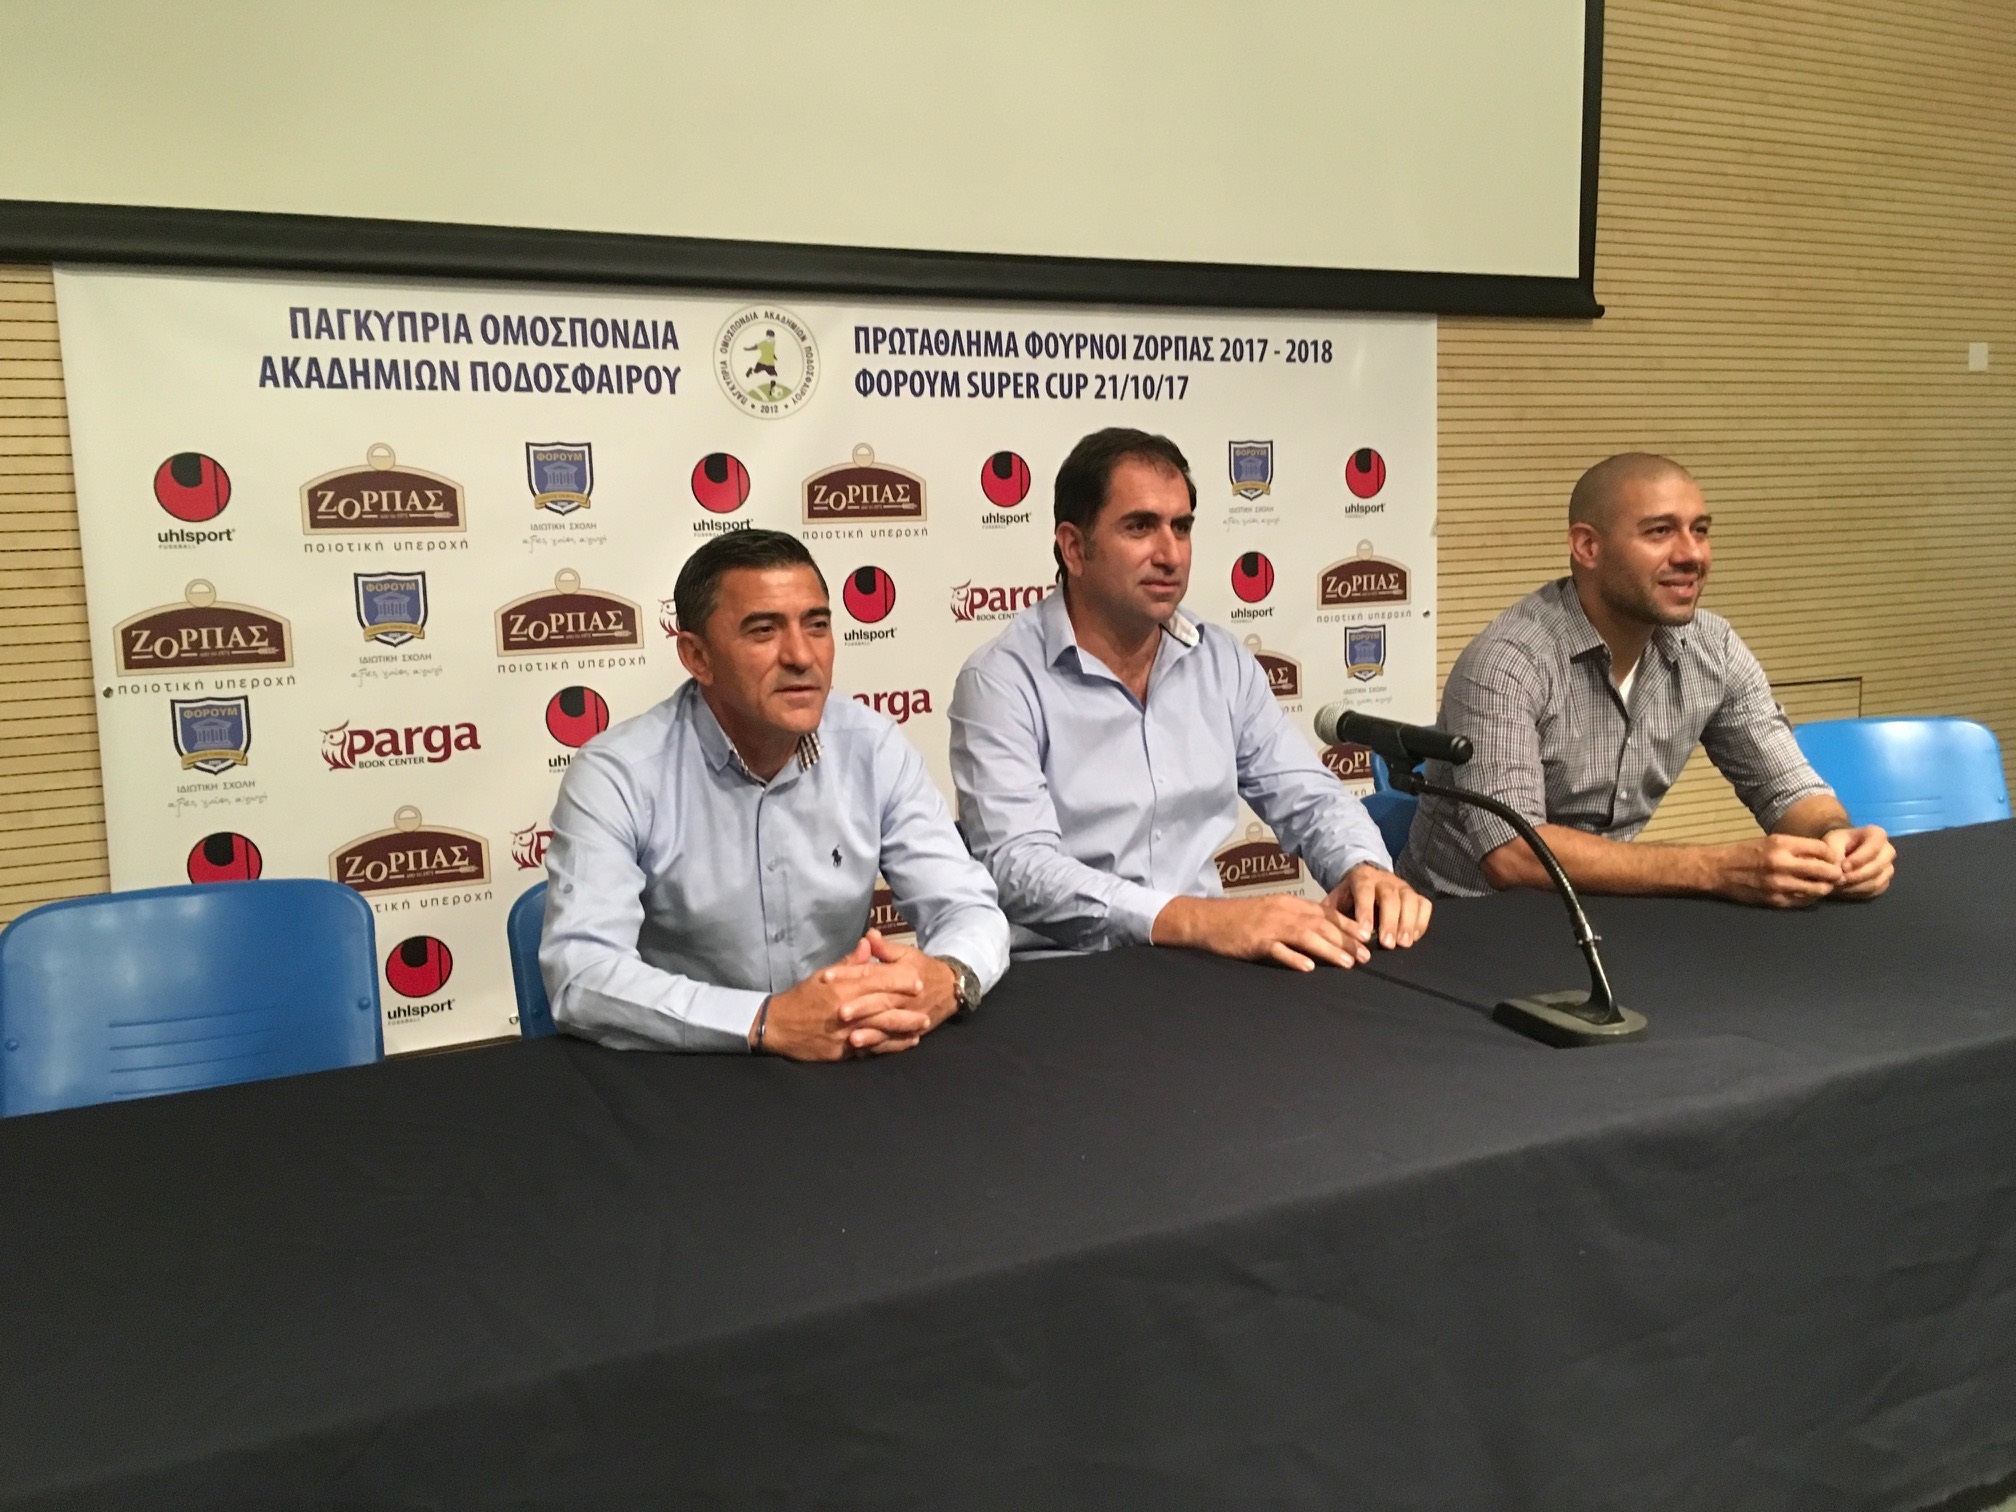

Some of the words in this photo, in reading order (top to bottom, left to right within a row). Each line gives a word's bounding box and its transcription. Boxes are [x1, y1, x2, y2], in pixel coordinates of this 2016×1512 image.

[289, 306, 473, 345] ΠΑΓΚΥΠΡΙΑ
[480, 313, 679, 351] ΟΜΟΣΠΟΝΔΙΑ
[854, 326, 1019, 358] ΠΡΩΤΑΘΛΗΜΑ
[1025, 331, 1127, 361] ΦΟΥΡΝΟΙ
[1133, 334, 1214, 362] ΖΟΡΠΑΣ
[1219, 337, 1268, 363] 2017
[1285, 338, 1333, 364] 2018
[259, 355, 460, 392] ΑΚΑΔΗΜΙΩΝ
[470, 361, 681, 395] ΠΟΔΟΣΦΑΙΡΟΥ
[855, 369, 960, 398] ΦΟΡΟΥΜ
[967, 372, 1040, 399] SUPER
[1045, 374, 1088, 399] CUP
[1094, 375, 1189, 401] 21/10/17
[760, 404, 779, 414] 2012
[536, 452, 583, 463] ΦΟΡΟΥΜ
[317, 489, 444, 520] ΖΟΡΠΑΣ
[813, 485, 911, 511] ΖΟΡΠΑΣ
[1344, 503, 1384, 515] uhlsport
[530, 523, 565, 531] ΙΔΙΩΤΙΚΗ
[569, 522, 597, 530] ΣΧΟΛΗ
[693, 519, 751, 533] uhlsport
[982, 512, 1030, 526] uhlsport
[157, 529, 233, 545] uhlsport
[802, 529, 864, 540] ποιοτική
[870, 527, 928, 540] υπεροχή
[304, 541, 384, 553] ποιοτική
[393, 538, 468, 553] υπεροχή
[365, 582, 416, 592] ΦΟΡΟΥΜ
[1326, 573, 1399, 599] ΖΟΡΠΑΣ
[968, 585, 1056, 617] parg
[1230, 607, 1273, 620] uhlsport
[509, 610, 623, 642] ΖΟΡΠΑΣ
[844, 627, 895, 642] uhlsport
[131, 625, 270, 660] ΖΟΡΠΑΣ
[359, 655, 398, 664] ΙΔΙΩΤΙΚΗ
[402, 653, 432, 662] ΣΧΟΛΗ
[498, 661, 569, 674] ποιοτική
[578, 655, 646, 669] υπεροχή
[118, 681, 205, 695] ποιοτική
[215, 675, 296, 691] υπεροχή
[183, 707, 238, 719] ΦΟΡΟΥΜ
[853, 689, 932, 724] rga
[347, 722, 481, 768] parga
[358, 760, 386, 769] BOOK
[389, 757, 425, 767] CENTER
[177, 783, 218, 793] ΙΔΙΩΤΙΚΗ
[223, 780, 256, 790] ΣΧΟΛΗ
[345, 845, 469, 882] ΖΟΡΠΑΣ
[374, 900, 410, 913] τική
[420, 890, 493, 908] υπεροχή
[387, 999, 453, 1019] uhlsport
